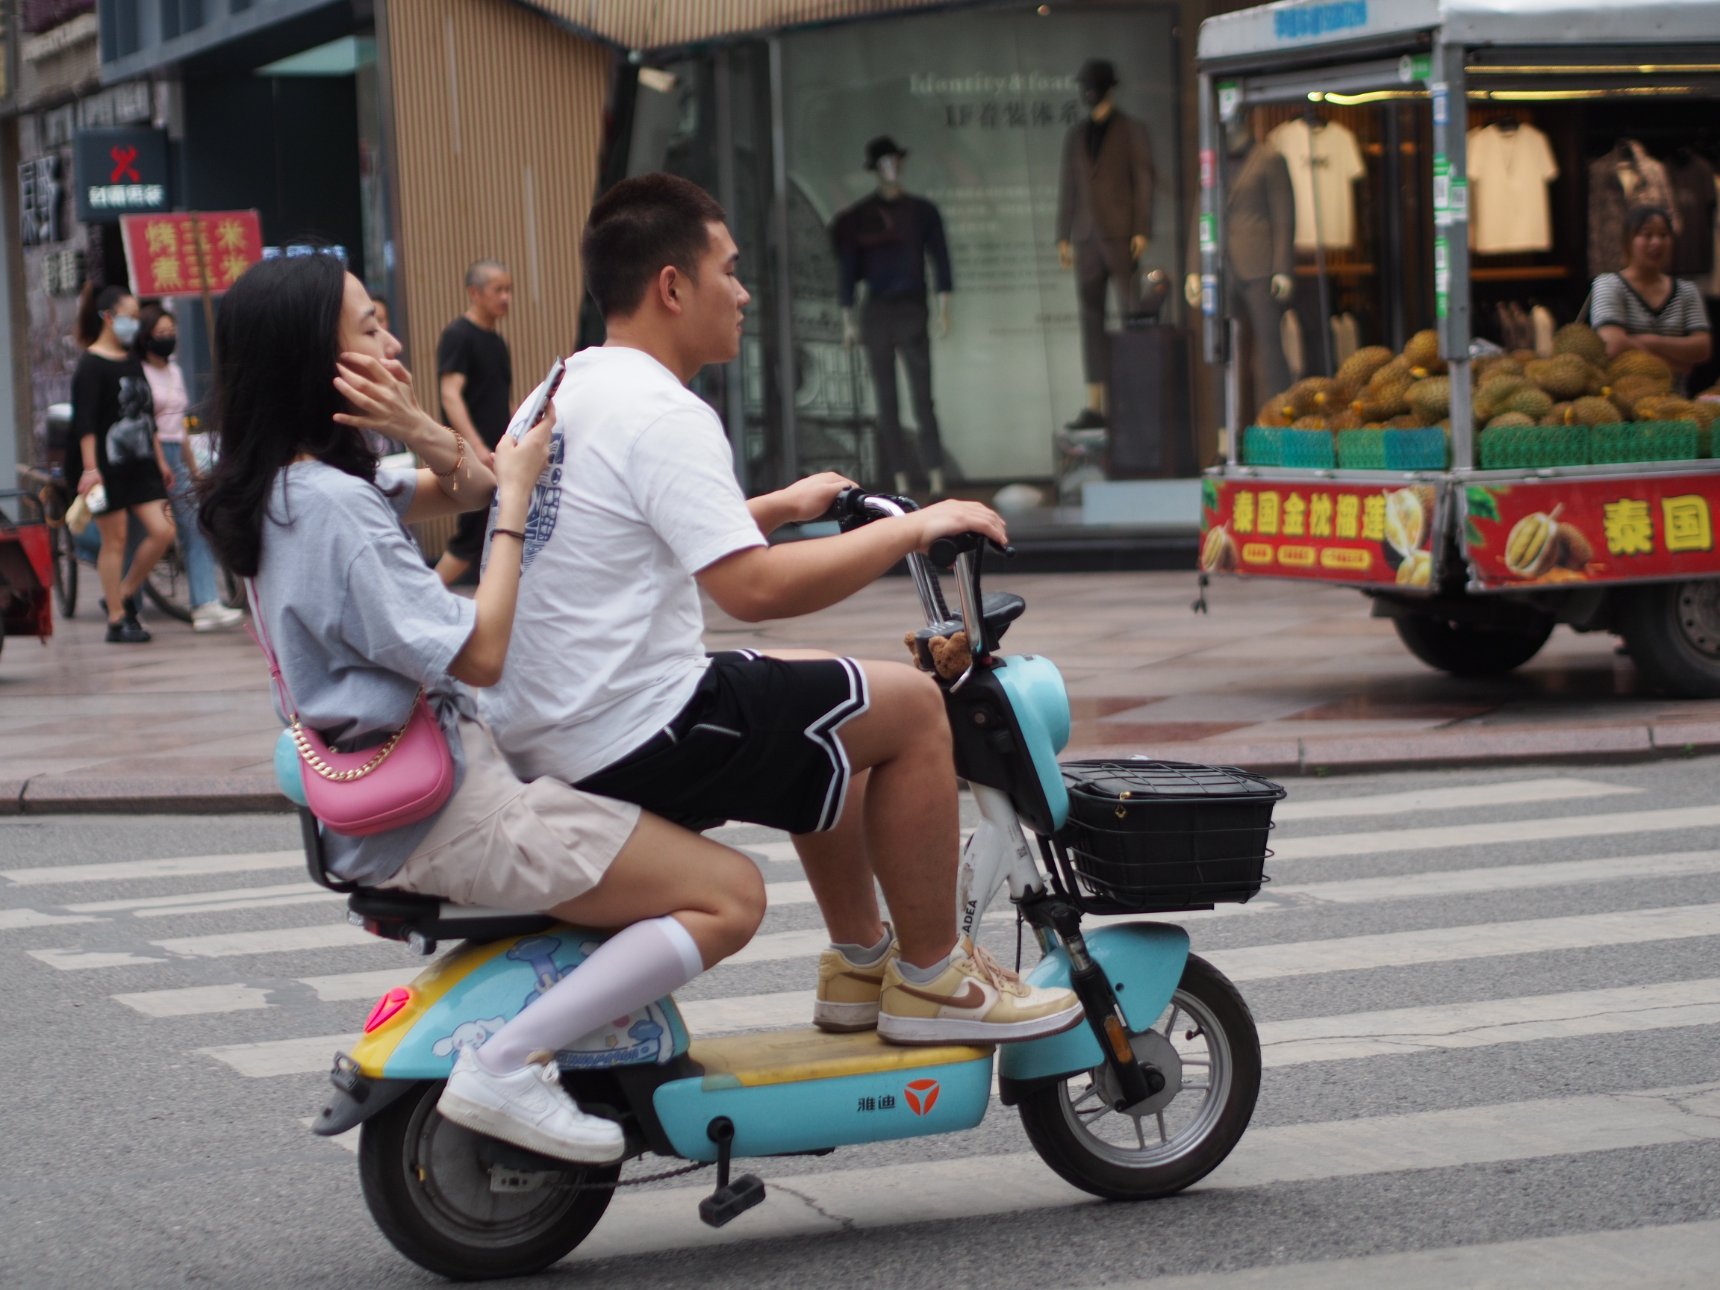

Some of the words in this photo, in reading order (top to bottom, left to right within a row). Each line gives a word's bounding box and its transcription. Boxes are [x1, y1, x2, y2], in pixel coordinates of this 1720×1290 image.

[1603, 494, 1711, 556] 泰国
[962, 899, 978, 936] ADEA
[857, 1094, 897, 1112] 雅迪
